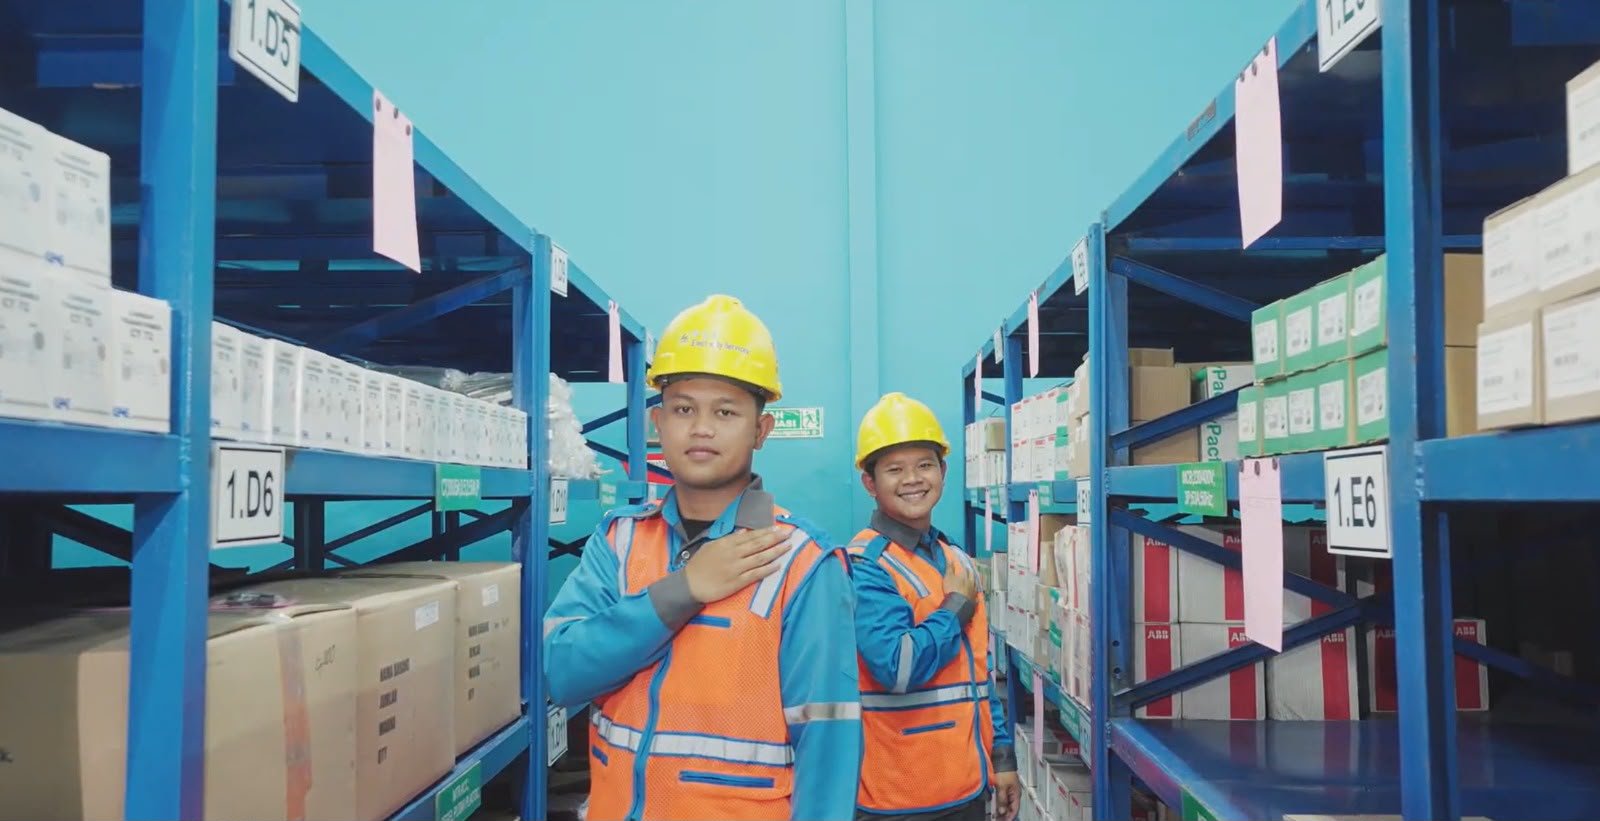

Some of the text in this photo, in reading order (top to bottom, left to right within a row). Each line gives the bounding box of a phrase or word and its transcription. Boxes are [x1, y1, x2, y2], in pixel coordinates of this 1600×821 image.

[248, 0, 290, 67] 1.D5
[1325, 0, 1365, 37] 1.E
[227, 470, 274, 519] 1.D6
[1334, 476, 1377, 528] 1.E6
[1147, 629, 1169, 640] ABB
[1323, 632, 1345, 643] ABB
[1456, 626, 1475, 636] ABB
